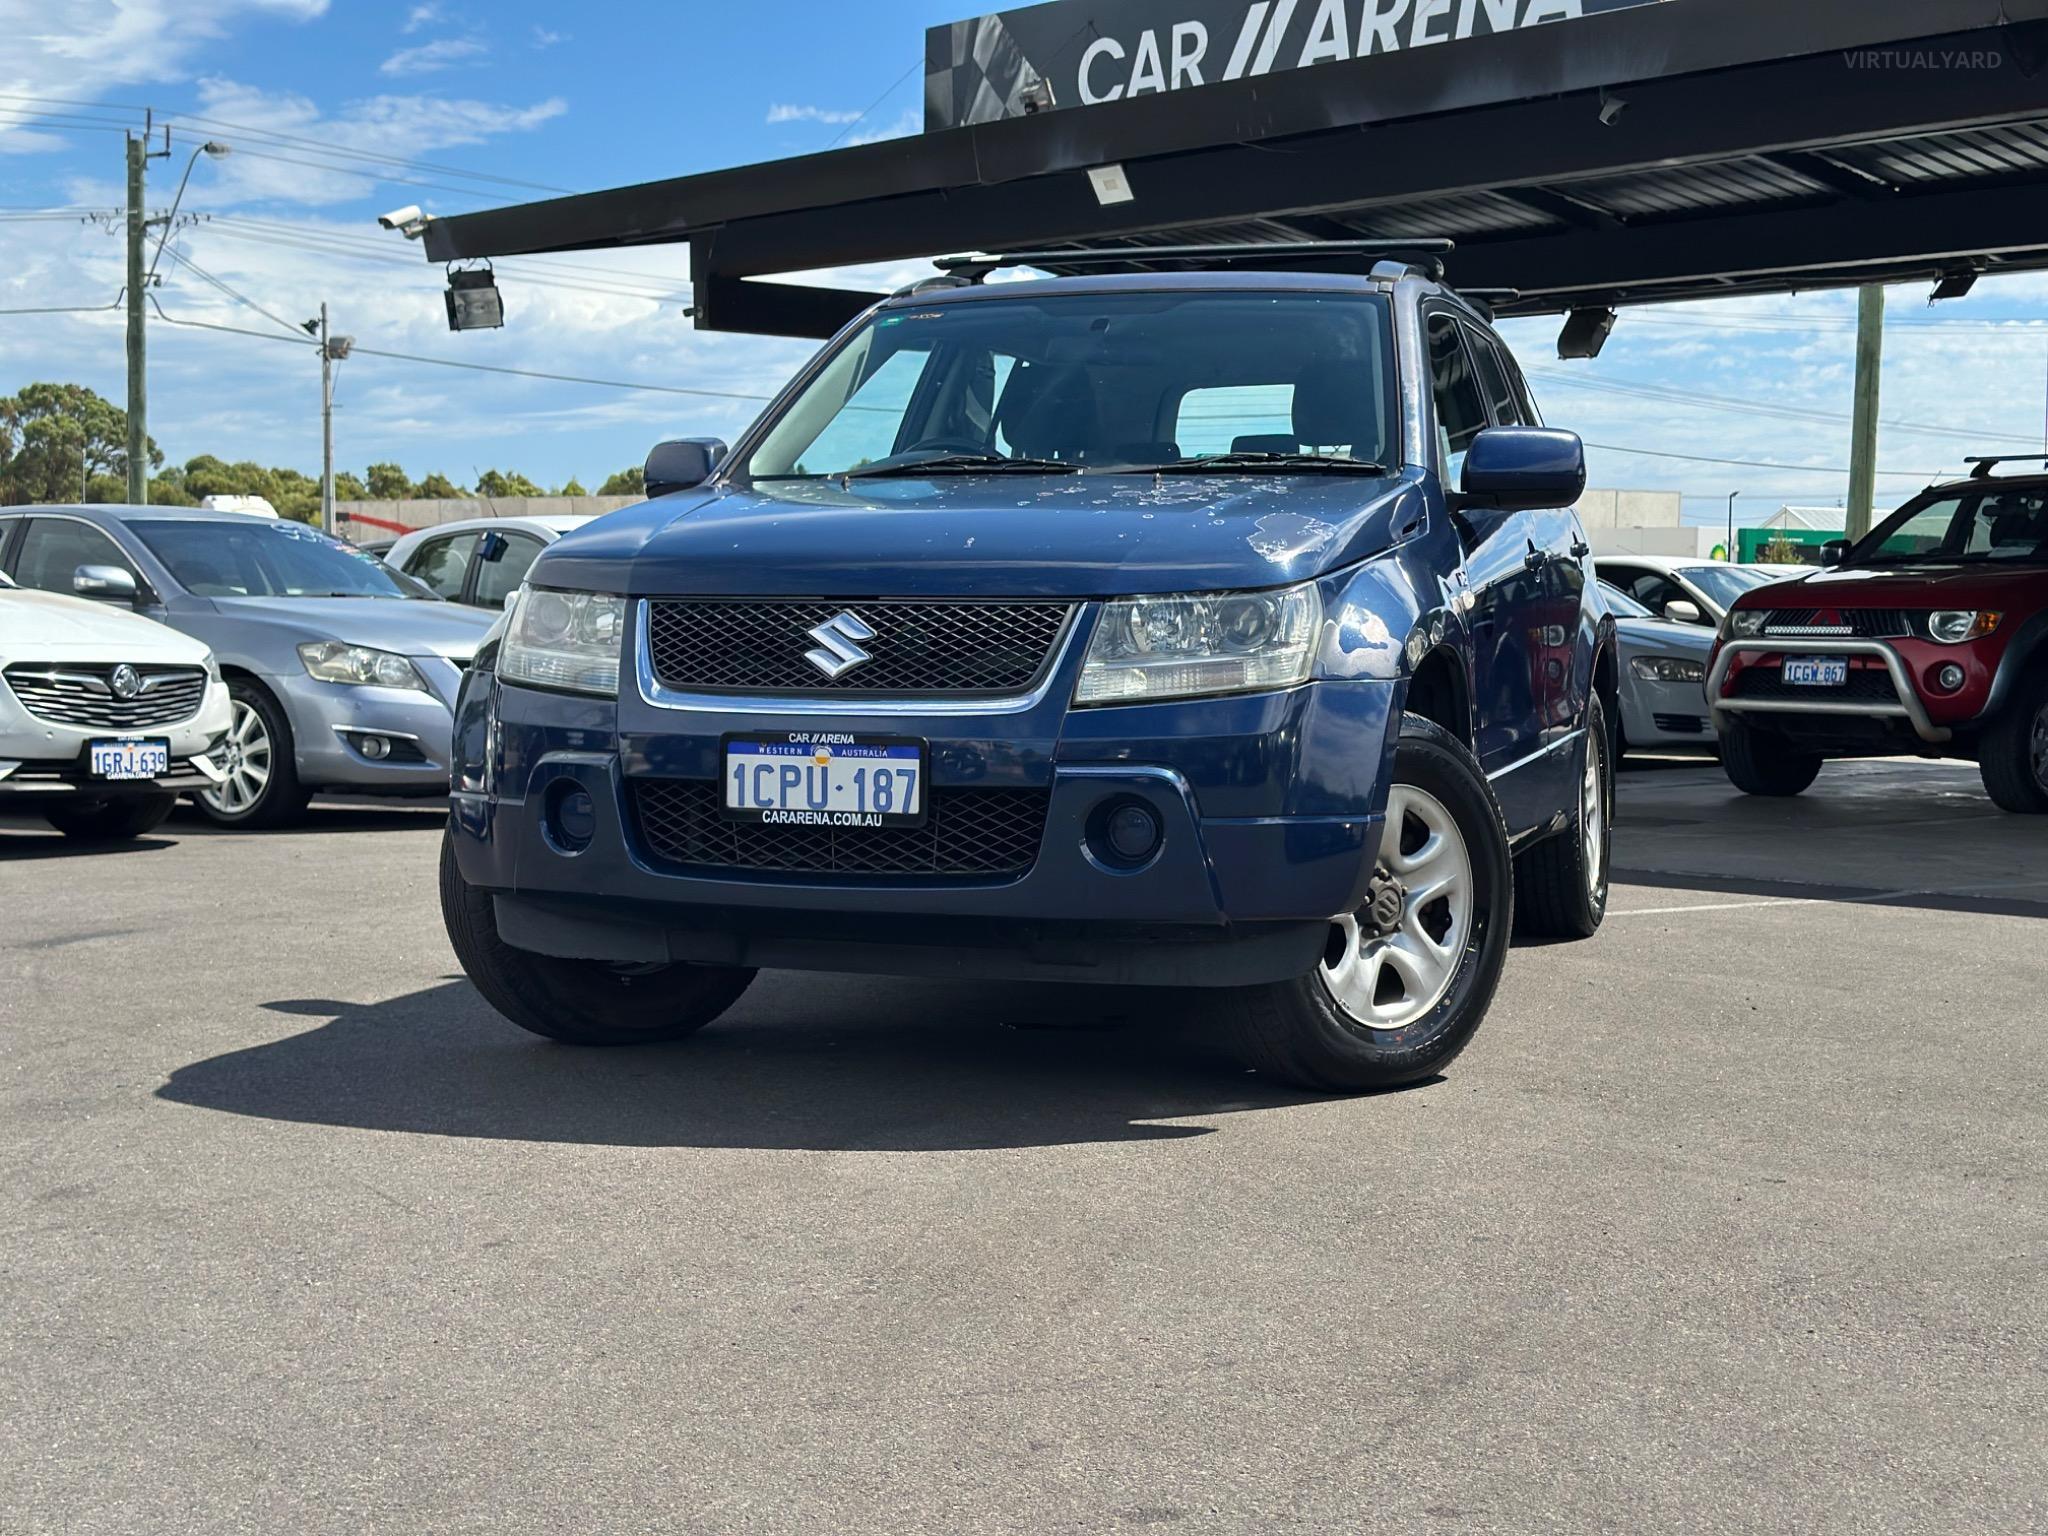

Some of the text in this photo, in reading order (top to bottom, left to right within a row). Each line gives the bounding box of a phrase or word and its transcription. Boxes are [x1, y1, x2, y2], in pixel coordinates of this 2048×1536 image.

[1078, 20, 1209, 105] CAR
[788, 733, 810, 743] CAR
[758, 746, 888, 757] WESTERN AUSTRALIA
[762, 810, 883, 827] CARARENA.COM.AU
